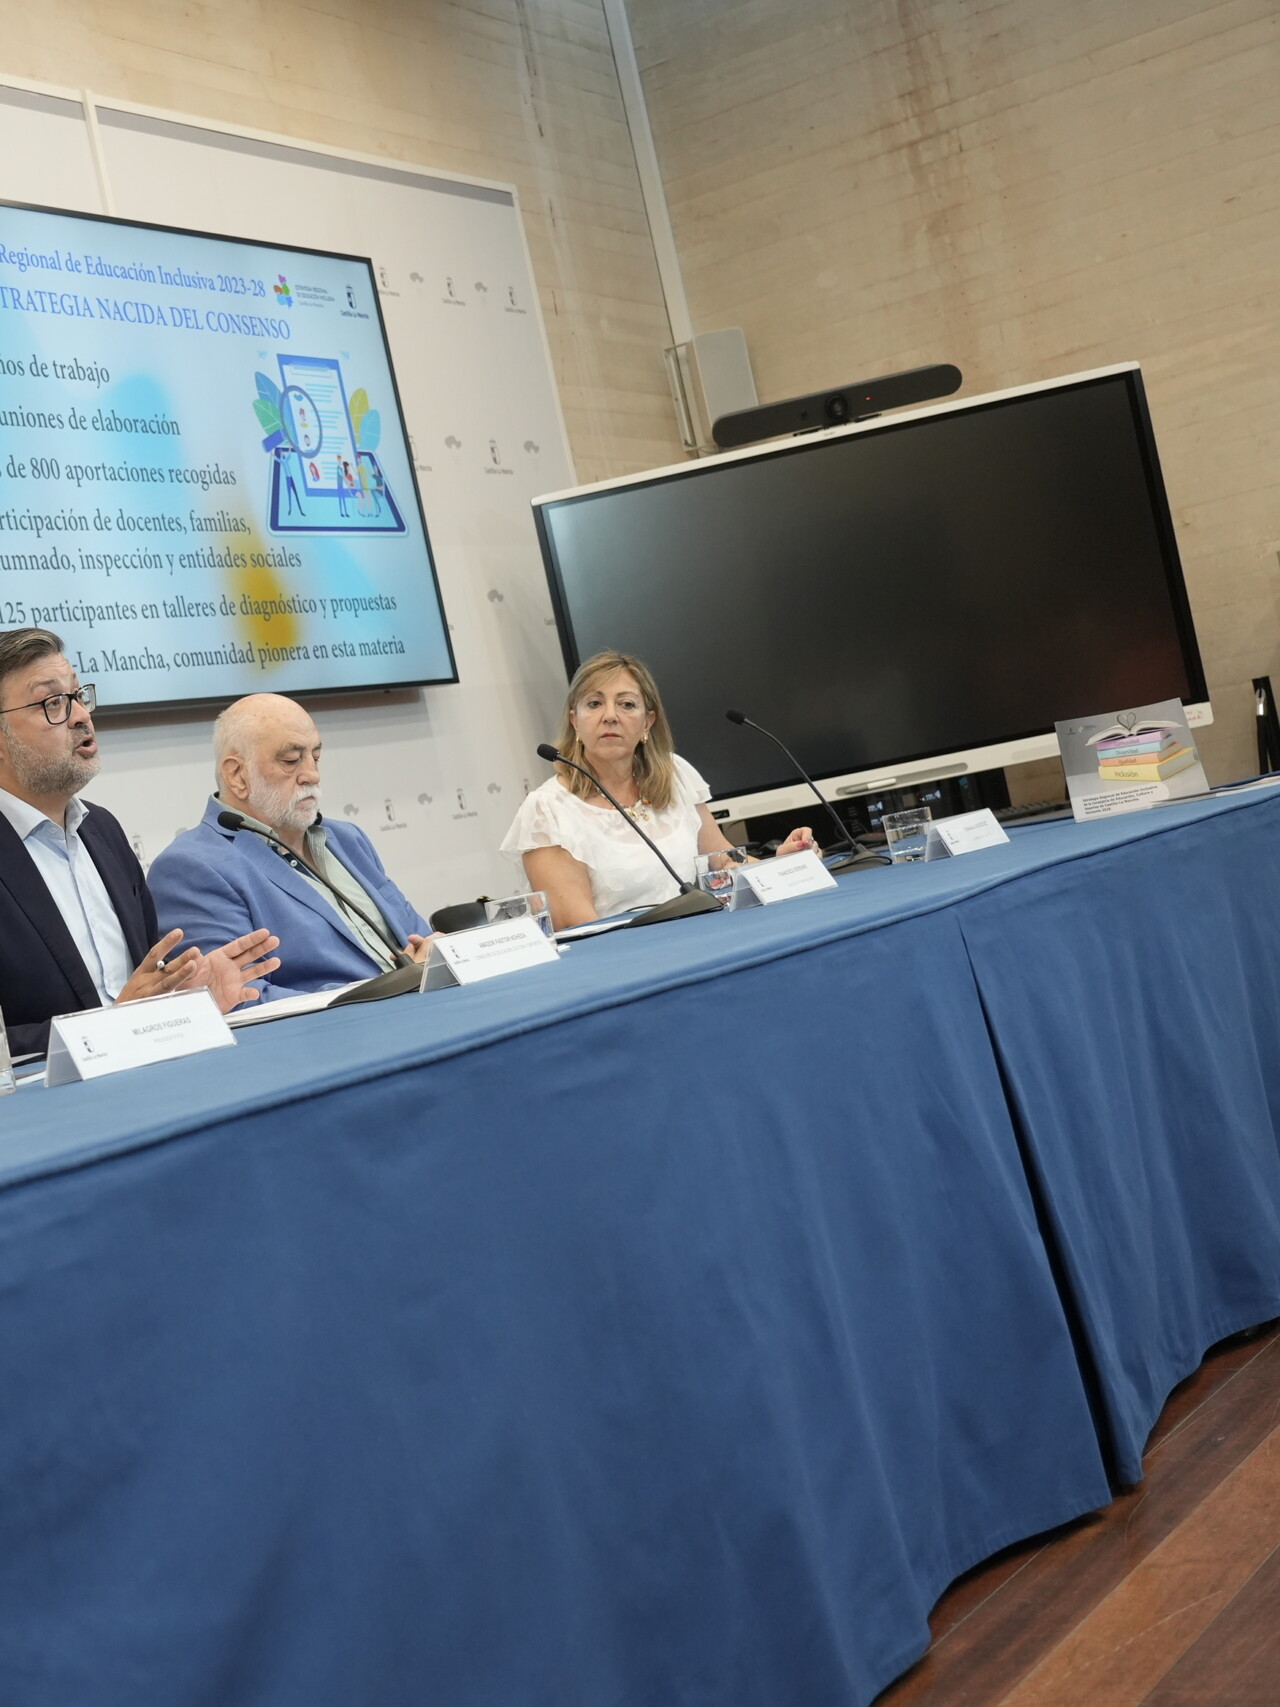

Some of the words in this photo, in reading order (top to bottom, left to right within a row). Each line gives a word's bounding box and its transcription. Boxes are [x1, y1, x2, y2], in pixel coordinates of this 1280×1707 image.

[65, 252, 82, 274] de
[84, 255, 156, 284] Educación
[157, 265, 216, 291] Inclusiva
[217, 275, 267, 297] 2023-28
[96, 296, 169, 327] NACIDA
[168, 306, 205, 331] DEL
[206, 311, 291, 340] CONSENSO
[29, 354, 49, 378] de
[53, 358, 110, 389] trabajo
[68, 407, 88, 431] de
[91, 408, 181, 436] elaboración
[6, 455, 26, 479] de
[30, 457, 61, 480] 800
[65, 461, 165, 487] aportaciones
[168, 463, 237, 491] recogidas
[93, 509, 112, 532] de
[116, 509, 187, 535] docentes,
[190, 510, 251, 535] familias,
[78, 547, 163, 577] inspección
[165, 554, 175, 576] y
[179, 546, 248, 569] entidades
[250, 546, 302, 569] sociales
[31, 600, 138, 628] participantes
[141, 602, 160, 619] en
[163, 595, 216, 618] talleres
[220, 594, 237, 617] de
[240, 593, 317, 622] diagnóstico
[320, 598, 327, 619] y
[330, 593, 397, 620] propuestas
[101, 647, 170, 672] Mancha,
[173, 641, 255, 668] comunidad
[259, 644, 311, 670] pionera
[313, 645, 330, 660] en
[332, 640, 356, 659] esta
[359, 635, 406, 656] materia
[132, 1023, 163, 1035] MILAGROS
